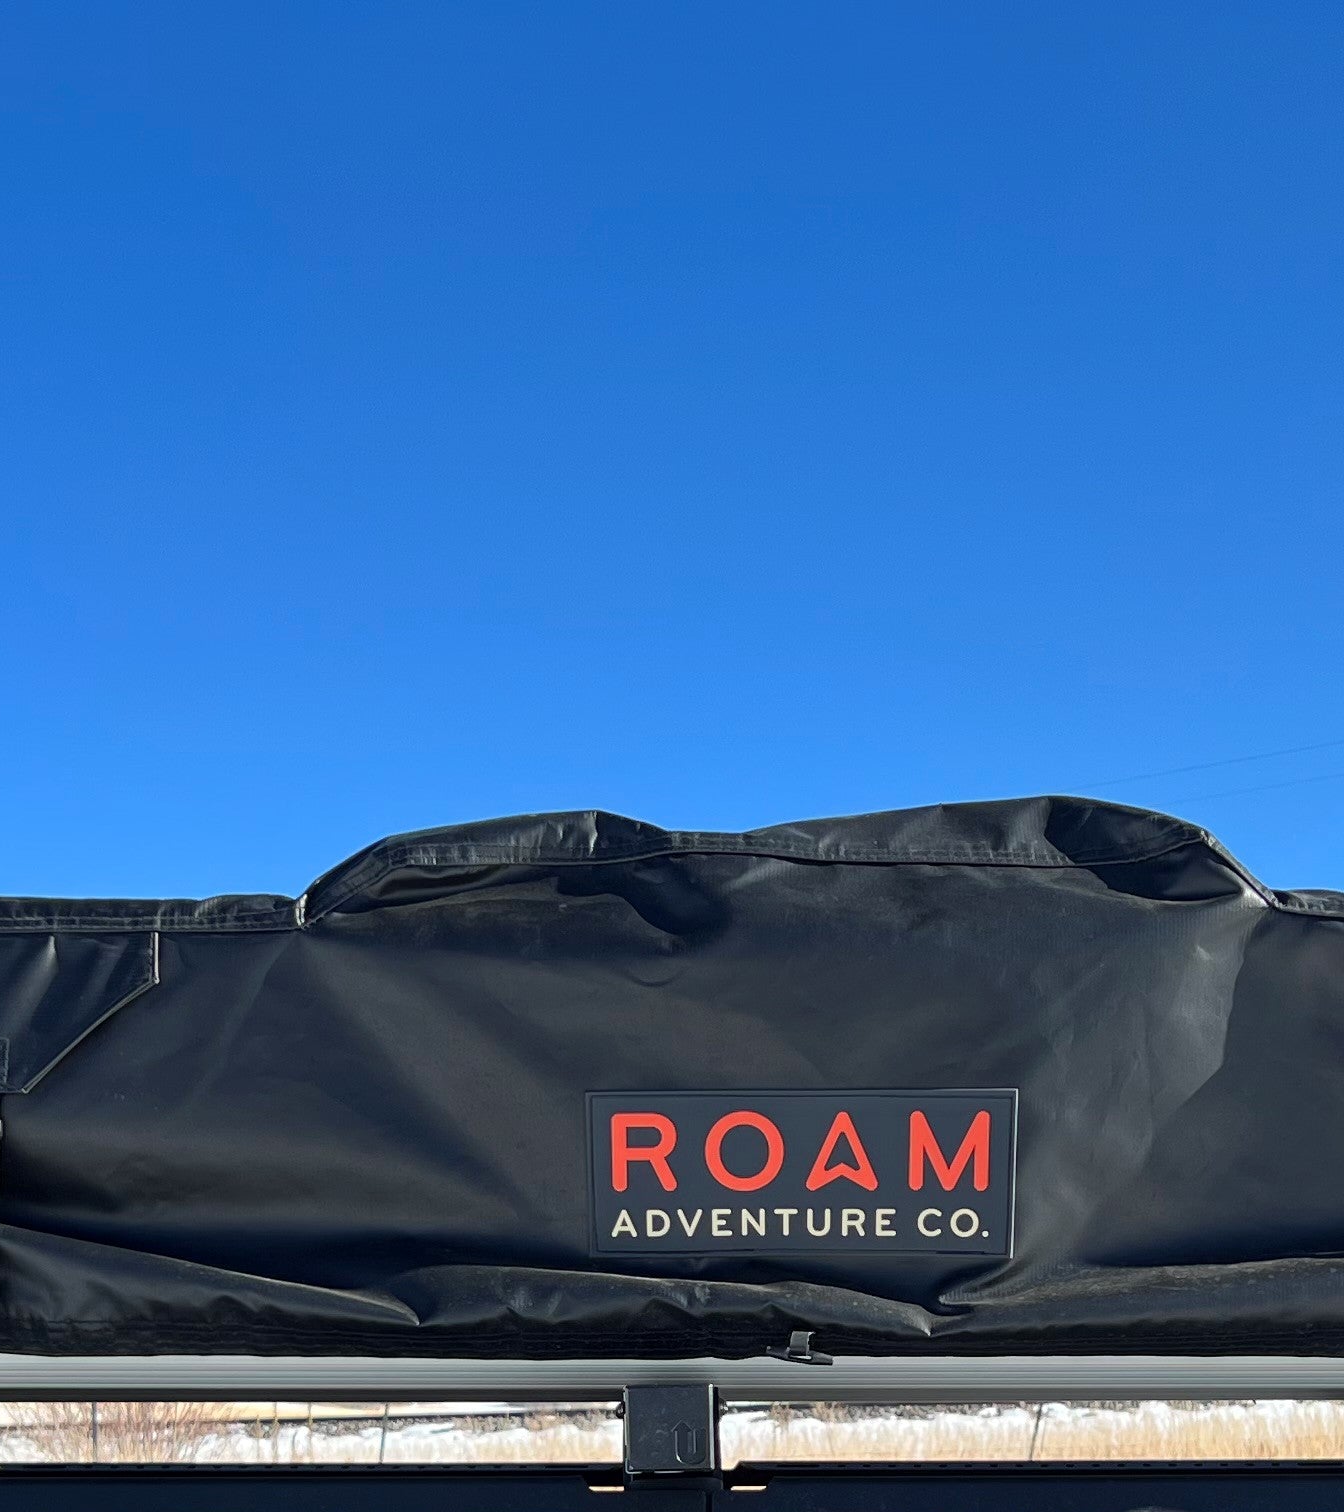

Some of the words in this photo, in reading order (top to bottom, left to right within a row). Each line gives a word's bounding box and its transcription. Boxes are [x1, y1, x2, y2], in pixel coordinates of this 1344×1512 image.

[610, 1109, 991, 1193] ROAM
[610, 1207, 897, 1238] ADVENTURE
[916, 1207, 990, 1238] CO.
